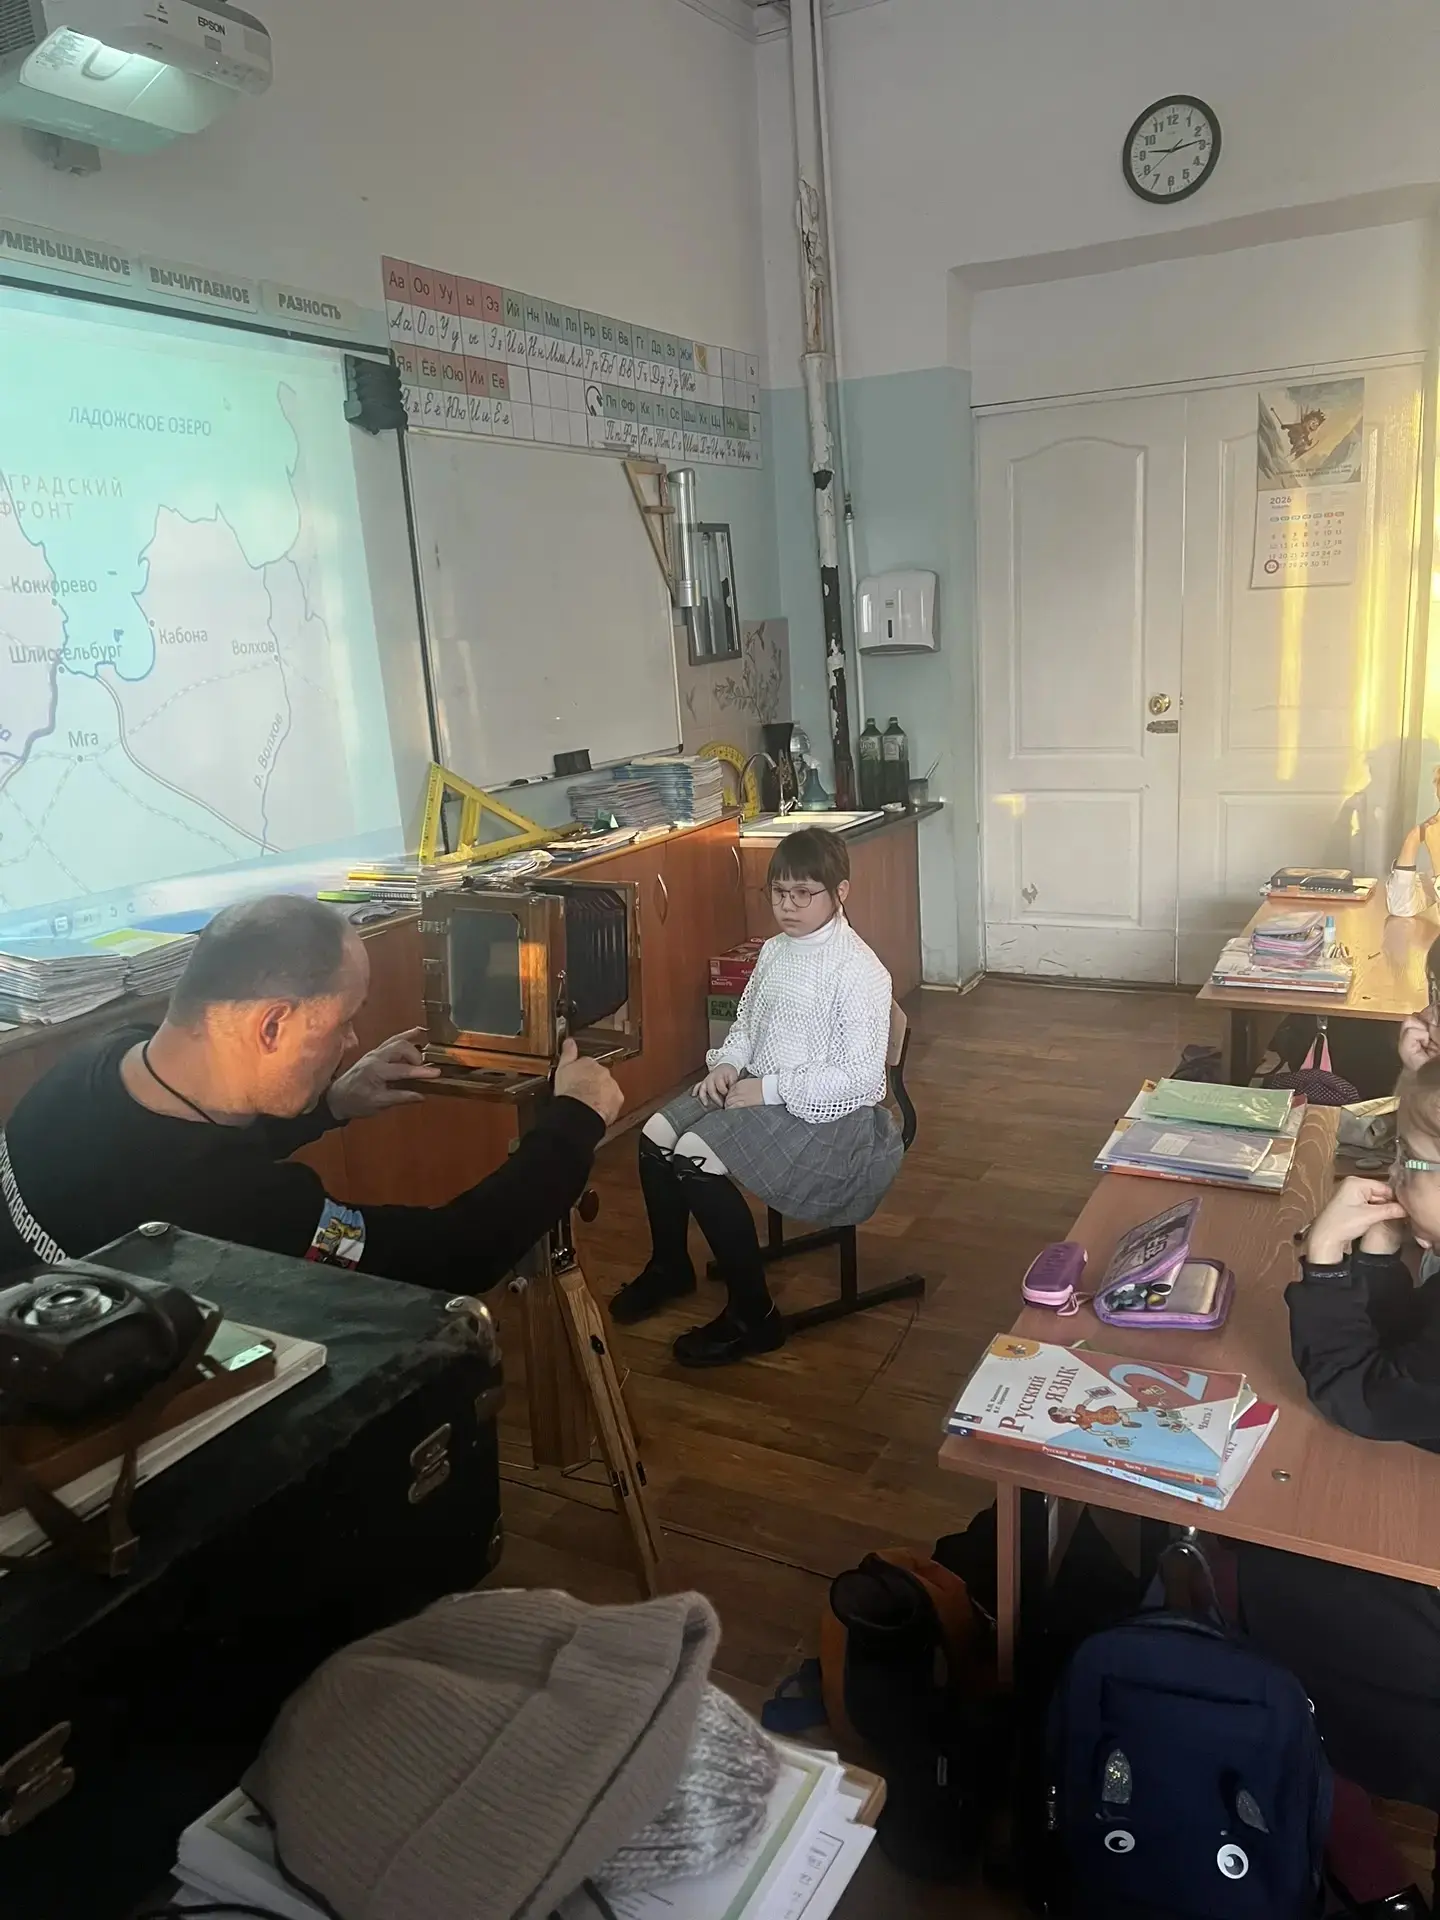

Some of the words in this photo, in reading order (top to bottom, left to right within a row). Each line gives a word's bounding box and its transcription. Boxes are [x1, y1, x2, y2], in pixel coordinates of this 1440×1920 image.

[197, 15, 226, 36] EPSON
[1153, 120, 1164, 133] 11
[1166, 114, 1179, 126] 12
[1144, 134, 1156, 146] 10
[1194, 126, 1202, 137] 2
[1139, 150, 1146, 161] 9
[1193, 155, 1200, 166] 4
[149, 266, 251, 305] ВЫЧИТАЕМОЕ
[277, 292, 343, 321] РАЗНОСТЬ
[413, 277, 430, 296] Оо
[439, 283, 453, 304] Уу
[526, 307, 540, 323] Нн
[545, 311, 560, 328] Мм
[583, 321, 596, 339] Рр
[601, 326, 613, 342] Бб
[442, 365, 464, 383] Юю
[469, 369, 484, 386] Ии
[492, 372, 505, 389] Ее
[606, 394, 617, 409] Пп
[621, 398, 636, 414] Фф
[640, 401, 650, 415] Кк
[670, 407, 680, 420] Сс
[68, 405, 165, 433] ЛАДОЖСКОЕ
[168, 415, 212, 437] ОЗЕРО
[1269, 495, 1293, 505] 2026
[10, 575, 98, 597] Коккорево
[159, 627, 209, 645] Кабона
[8, 641, 123, 664] Шлиссельбург
[232, 639, 275, 656] Волхов
[68, 730, 99, 749] Мга
[257, 713, 284, 770] Волхов
[997, 1375, 1047, 1433] Русский
